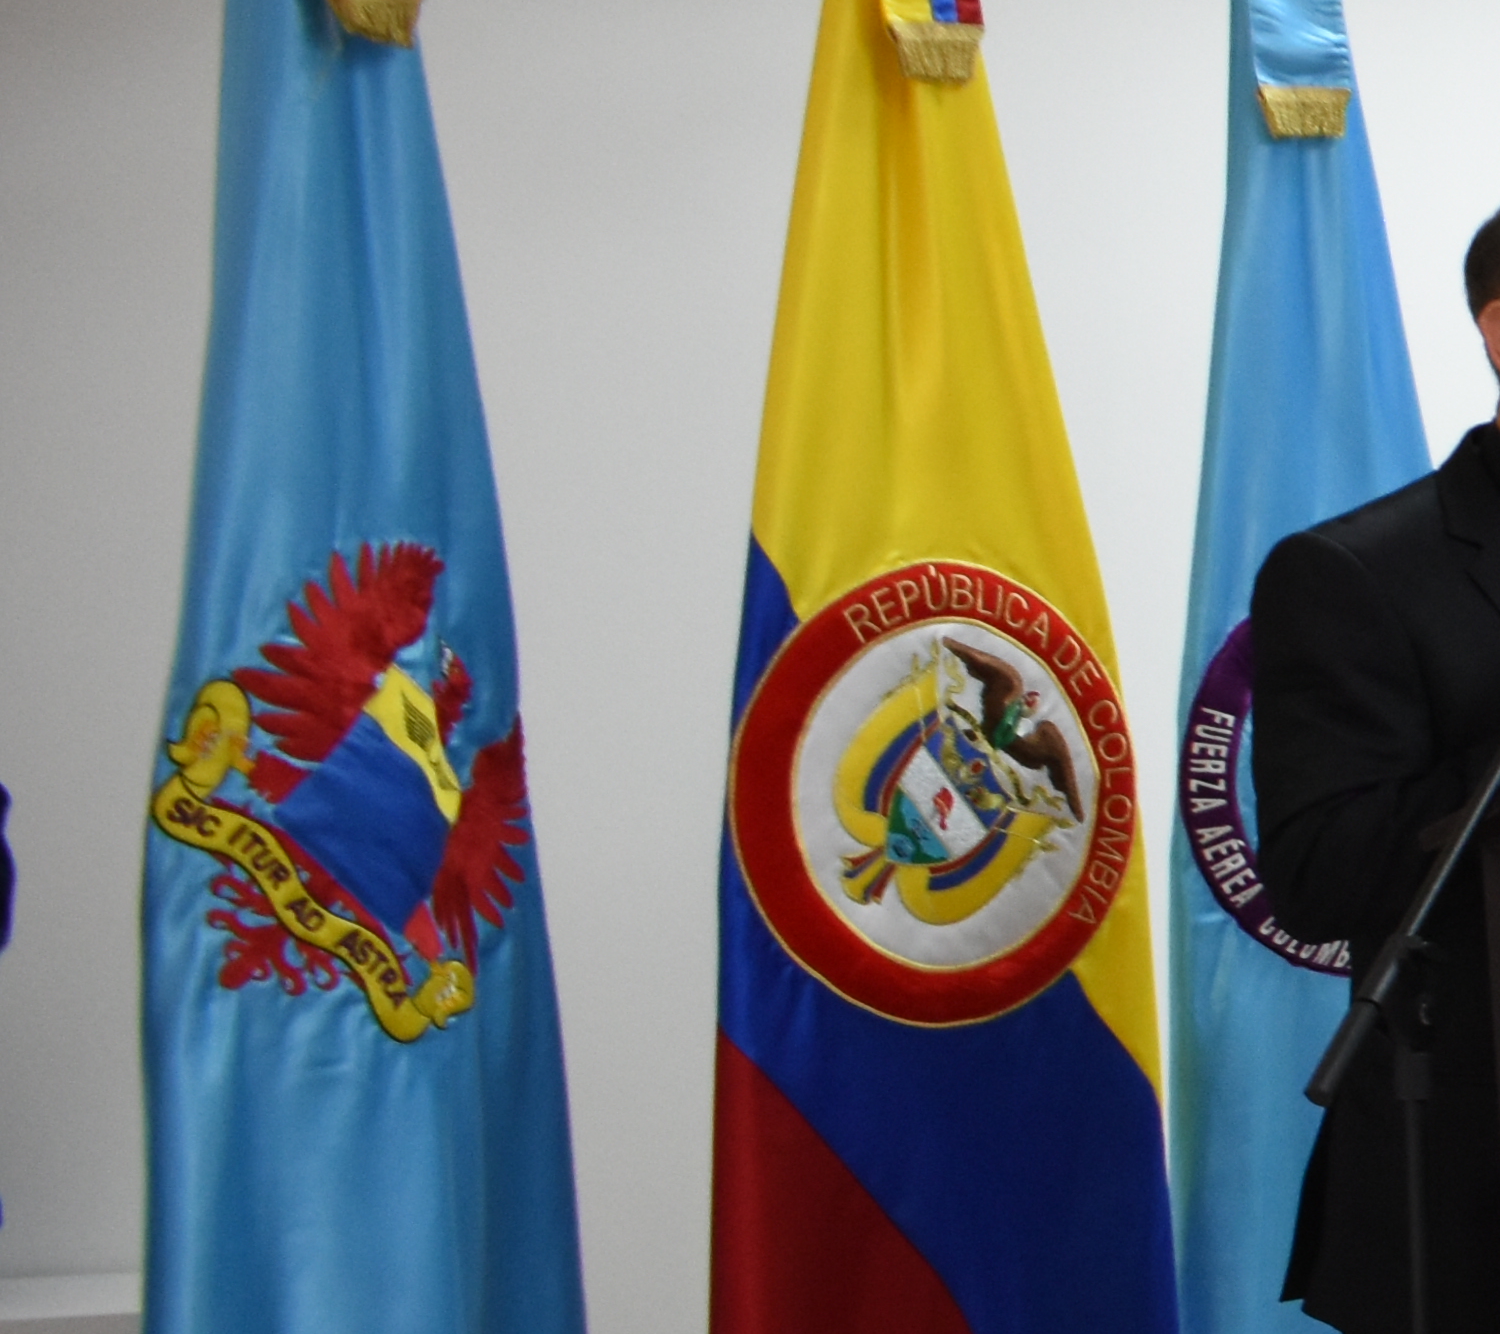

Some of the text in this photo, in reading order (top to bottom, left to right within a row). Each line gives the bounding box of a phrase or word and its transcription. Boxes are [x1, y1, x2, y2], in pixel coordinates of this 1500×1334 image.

[843, 564, 1133, 926] REPÚBLICA DE COLOMBIA
[1188, 706, 1236, 814] FUERZA
[227, 823, 292, 891] ITUR
[285, 896, 326, 933] AD
[336, 929, 408, 1011] ASTRA
[1194, 824, 1265, 909] AÉREA
